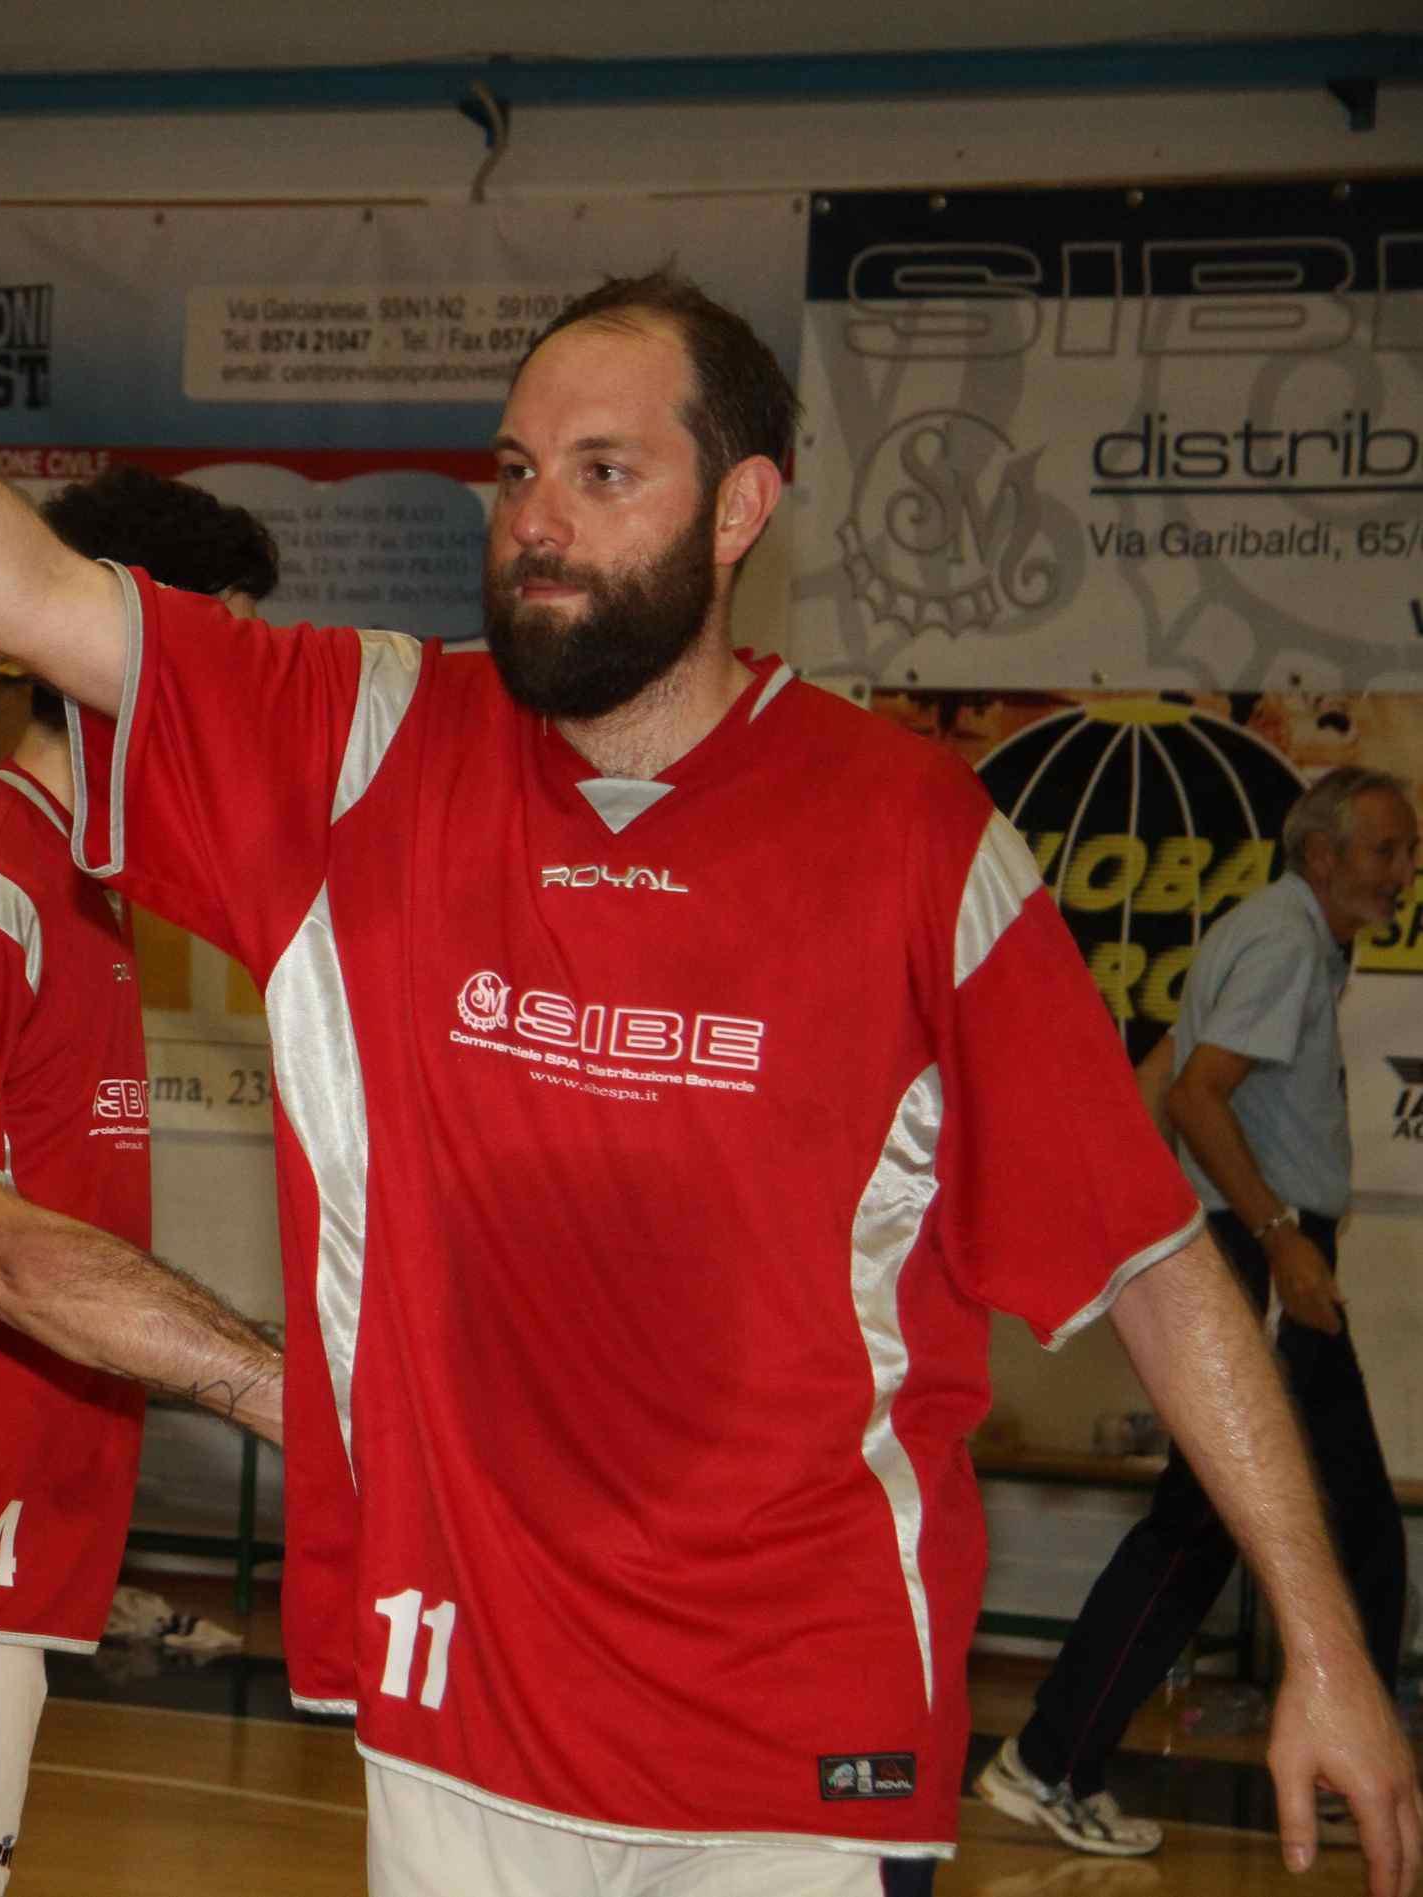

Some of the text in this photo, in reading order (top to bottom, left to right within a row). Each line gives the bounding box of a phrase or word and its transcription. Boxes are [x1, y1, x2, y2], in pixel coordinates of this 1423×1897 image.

[844, 233, 1423, 361] SIB
[259, 328, 308, 354] 0574
[313, 328, 373, 354] 21047
[1088, 520, 1423, 563] Via Garibaldi, 65/
[541, 864, 689, 893] ROYAL
[514, 989, 765, 1072] SIBE
[228, 1068, 274, 1104] 23
[449, 1029, 757, 1094] Commerciale SPA Distribuzione Bevande
[374, 1587, 457, 1712] 11
